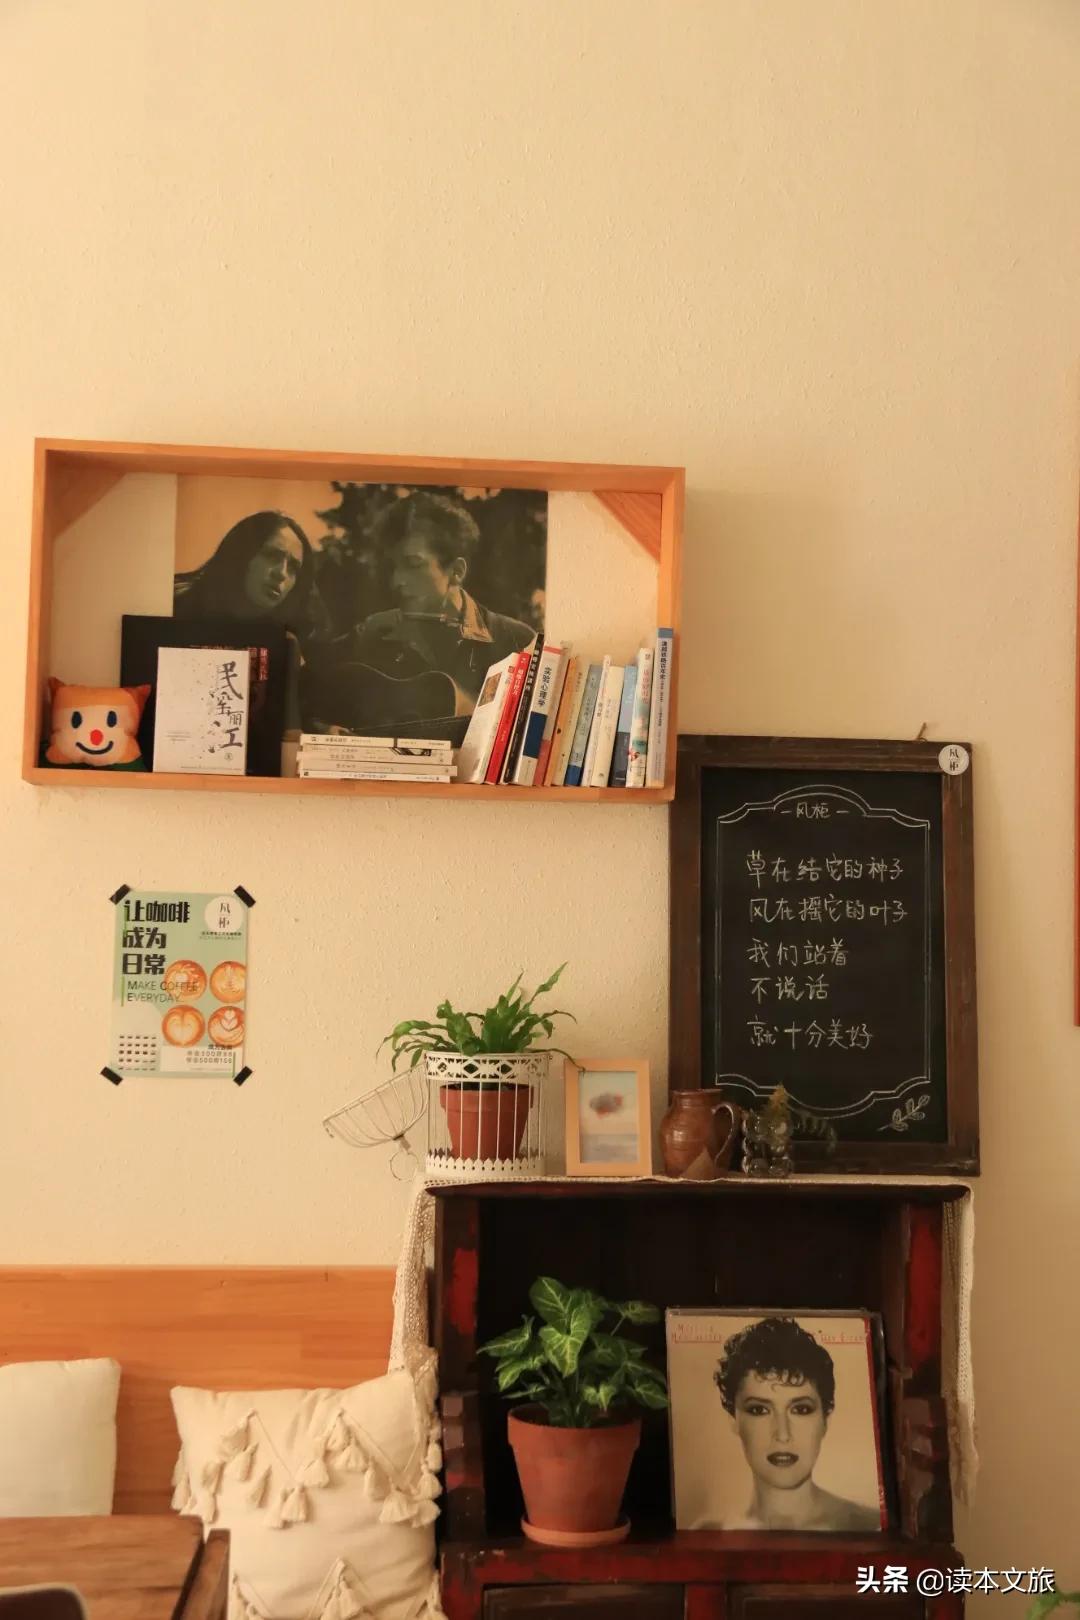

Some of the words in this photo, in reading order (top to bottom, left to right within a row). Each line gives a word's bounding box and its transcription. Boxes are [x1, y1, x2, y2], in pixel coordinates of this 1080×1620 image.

[746, 850, 903, 888] 草在结它的种子
[124, 900, 190, 923] 让咖啡
[750, 894, 908, 925] 风在摇它的叶子
[122, 926, 167, 949] 成为
[122, 953, 166, 975] 日常
[747, 937, 848, 968] 我们站着
[127, 981, 156, 991] MAKE
[160, 981, 199, 992] COFFEE
[127, 993, 180, 1003] EVERYDAY
[750, 973, 829, 1004] 不说话
[746, 1014, 873, 1050] 就十分美好
